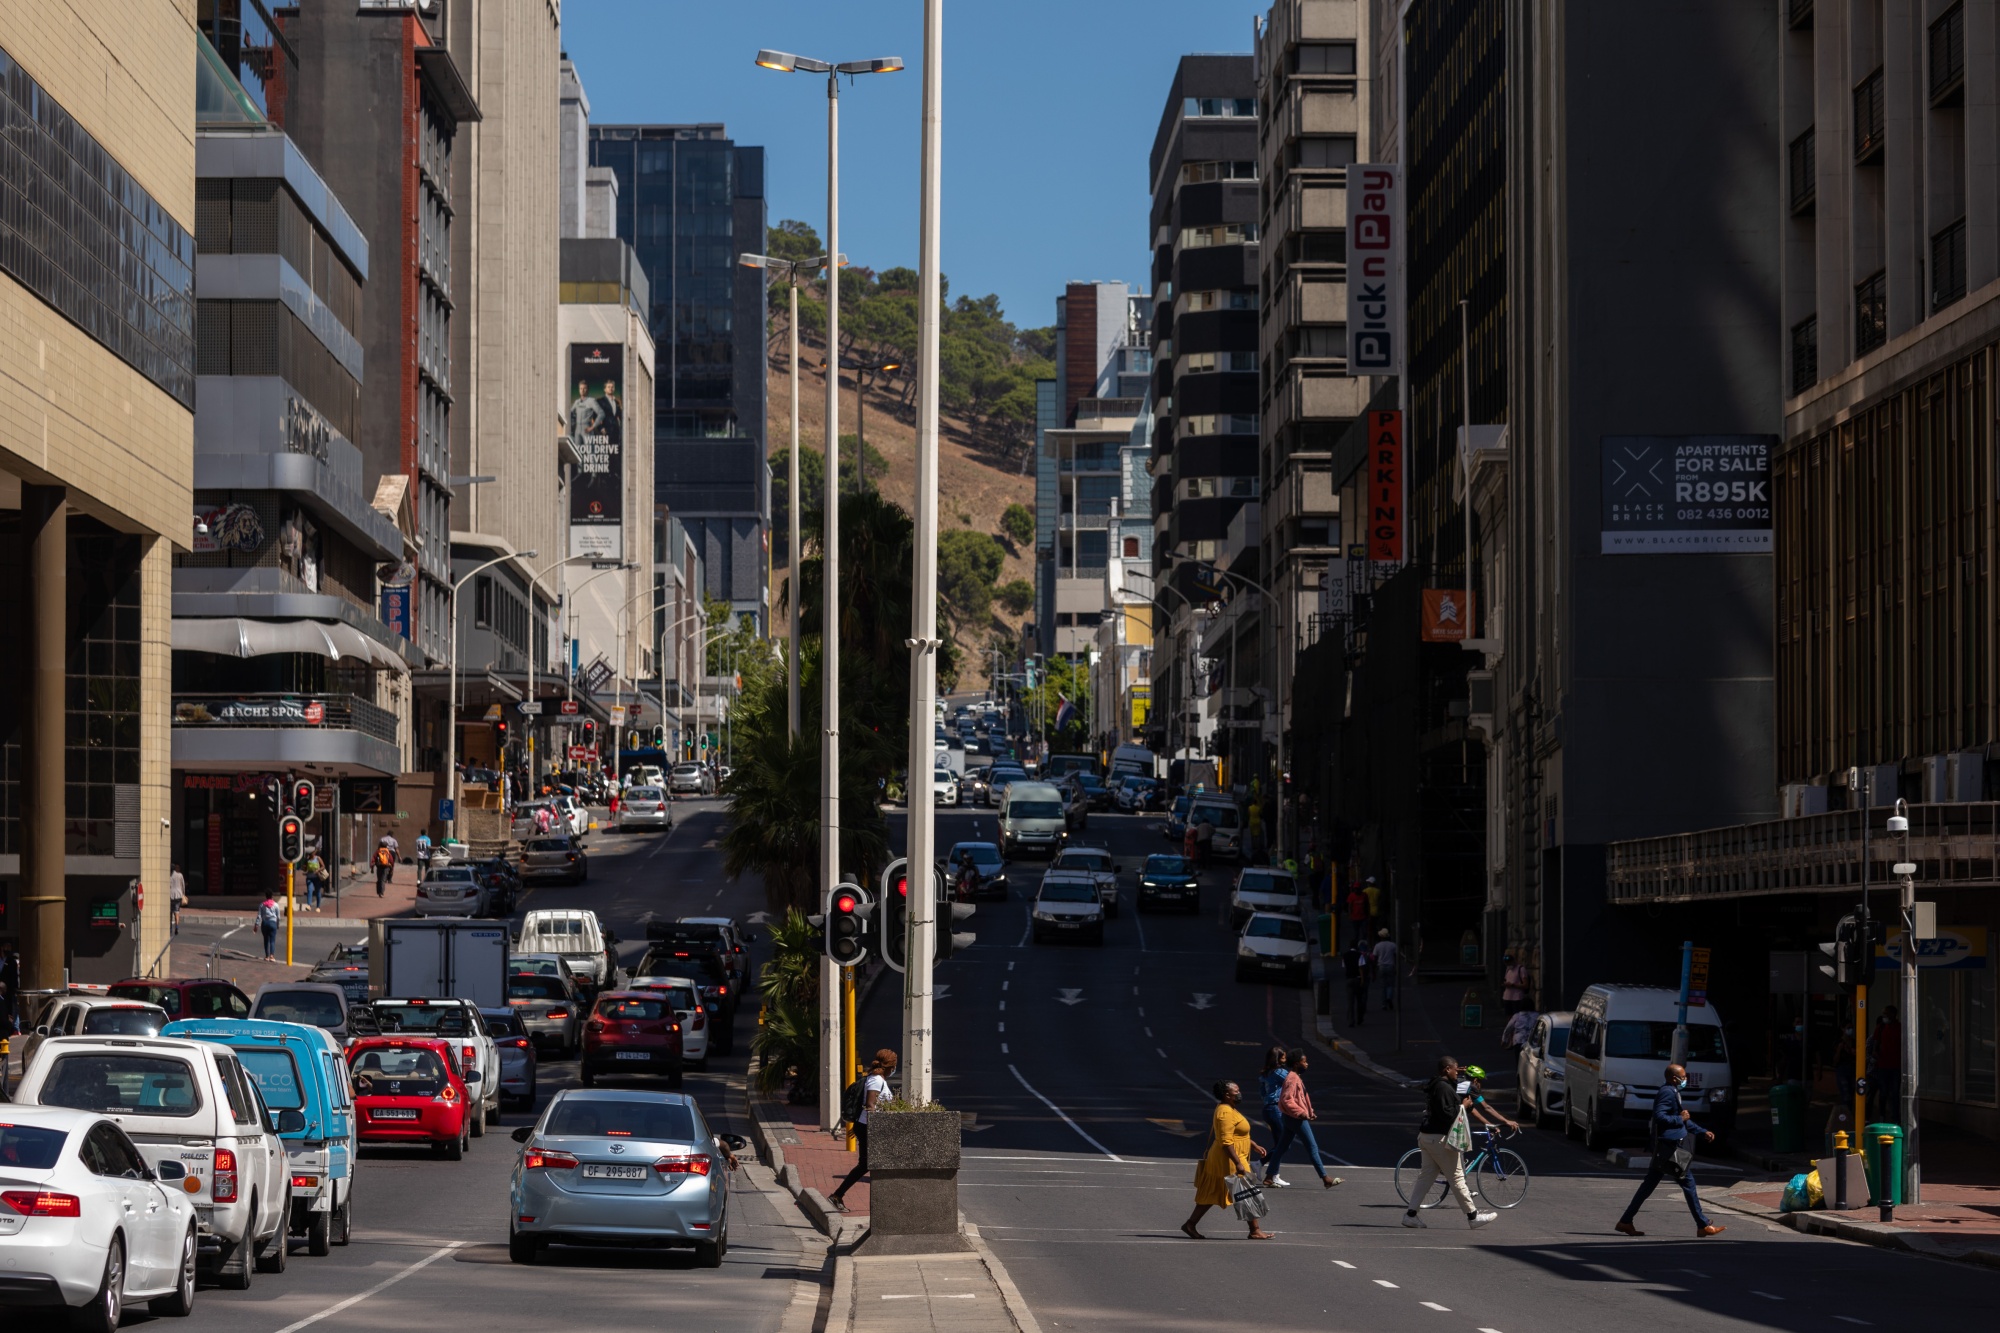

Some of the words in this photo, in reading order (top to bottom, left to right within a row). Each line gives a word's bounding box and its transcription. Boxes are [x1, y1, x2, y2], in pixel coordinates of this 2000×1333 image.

[1355, 171, 1393, 250] Pay
[1363, 257, 1385, 276] n
[1355, 283, 1391, 367] Pick
[585, 435, 609, 445] WHEN
[594, 445, 619, 455] DRIVE
[1676, 445, 1767, 456] APARTMENTS
[583, 455, 609, 464] NEVER
[1675, 458, 1714, 472] FOR
[1719, 457, 1767, 471] SALE
[583, 464, 609, 473] DRINK
[1378, 413, 1396, 541] PARKING
[1676, 481, 1767, 502] R895K
[1613, 504, 1664, 512] BLACK
[1613, 513, 1664, 521] BRICK
[1677, 509, 1703, 520] 082
[1707, 508, 1733, 519] 436
[1736, 508, 1770, 519] 0012
[1614, 536, 1769, 544] WWW.BLACKBRICK.CLUB
[221, 707, 269, 717] APACHE
[272, 707, 303, 717] SPUR
[184, 776, 230, 789] APACHE
[270, 1074, 294, 1086] CO.
[588, 1166, 599, 1176] CF
[606, 1166, 643, 1177] 295-887
